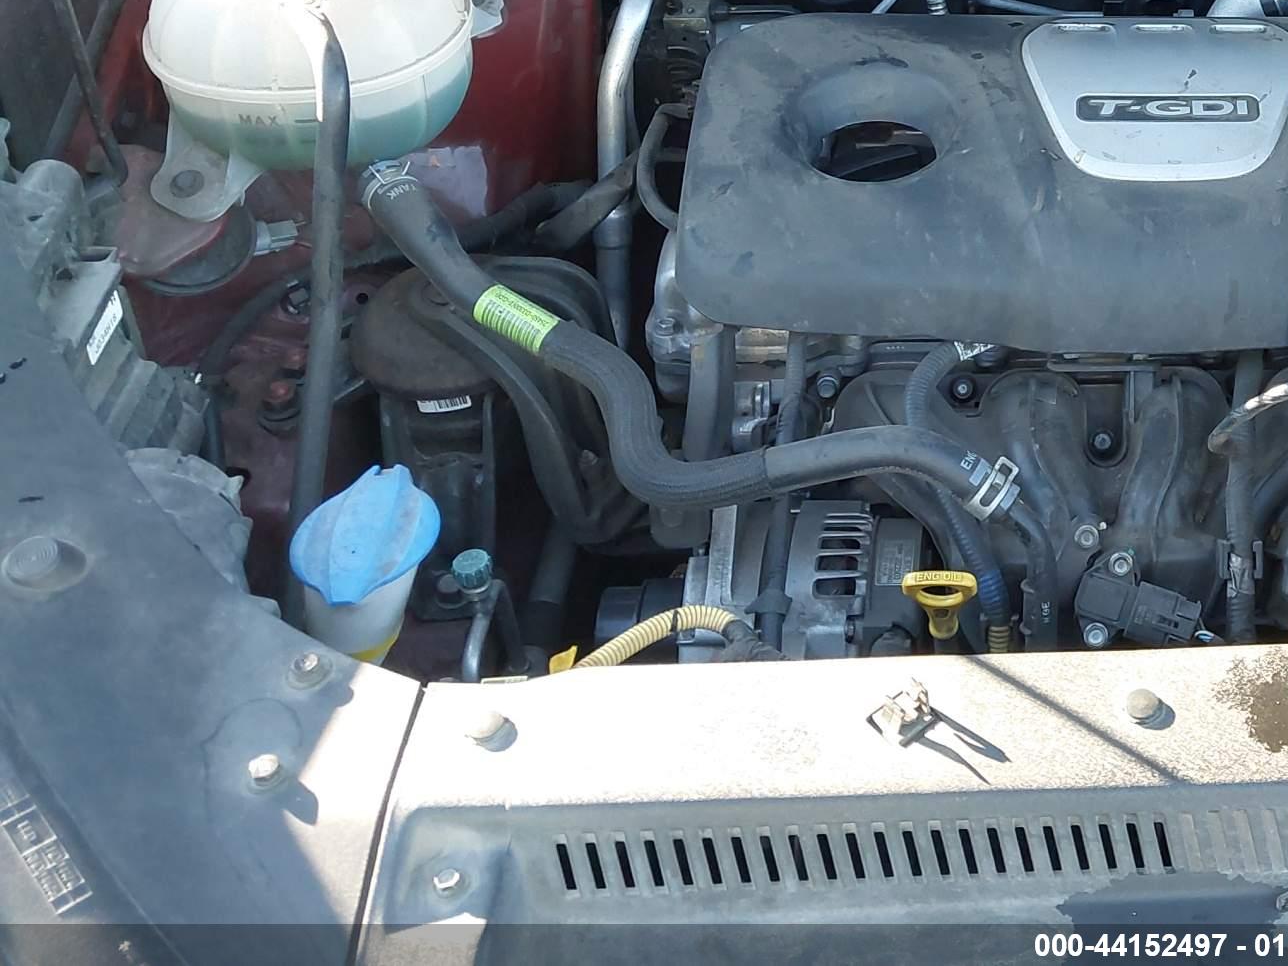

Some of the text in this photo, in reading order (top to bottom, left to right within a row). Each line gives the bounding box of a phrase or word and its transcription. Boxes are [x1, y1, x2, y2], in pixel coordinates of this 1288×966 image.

[1087, 97, 1249, 119] T-GDI
[238, 113, 281, 128] MAX
[915, 571, 962, 582] ENG OIL
